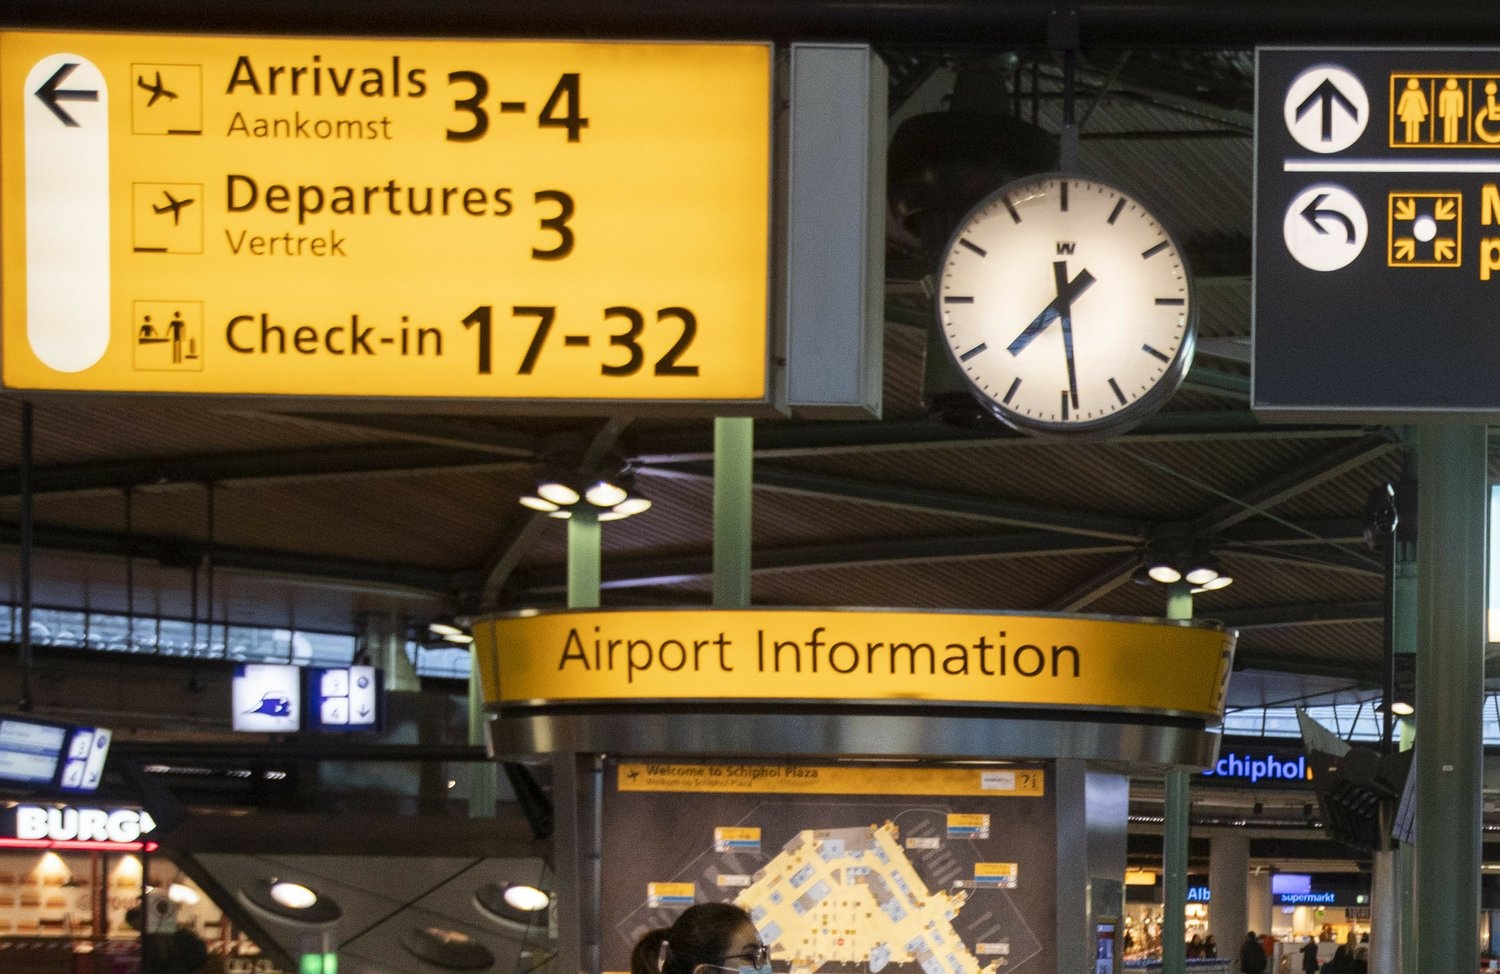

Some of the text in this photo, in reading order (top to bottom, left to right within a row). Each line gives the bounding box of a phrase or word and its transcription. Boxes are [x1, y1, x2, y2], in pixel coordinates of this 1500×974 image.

[226, 55, 589, 143] Arrivals 3-4
[226, 110, 392, 140] Aankomst
[226, 173, 576, 261] Departures 3
[225, 230, 346, 257] Vertrek
[225, 305, 700, 378] Check-in 17-32
[558, 627, 1082, 684] Airport Information
[646, 765, 819, 780] Welcome to Schiphol Plaza
[1202, 754, 1304, 782] chiphol
[1187, 887, 1211, 900] Alb
